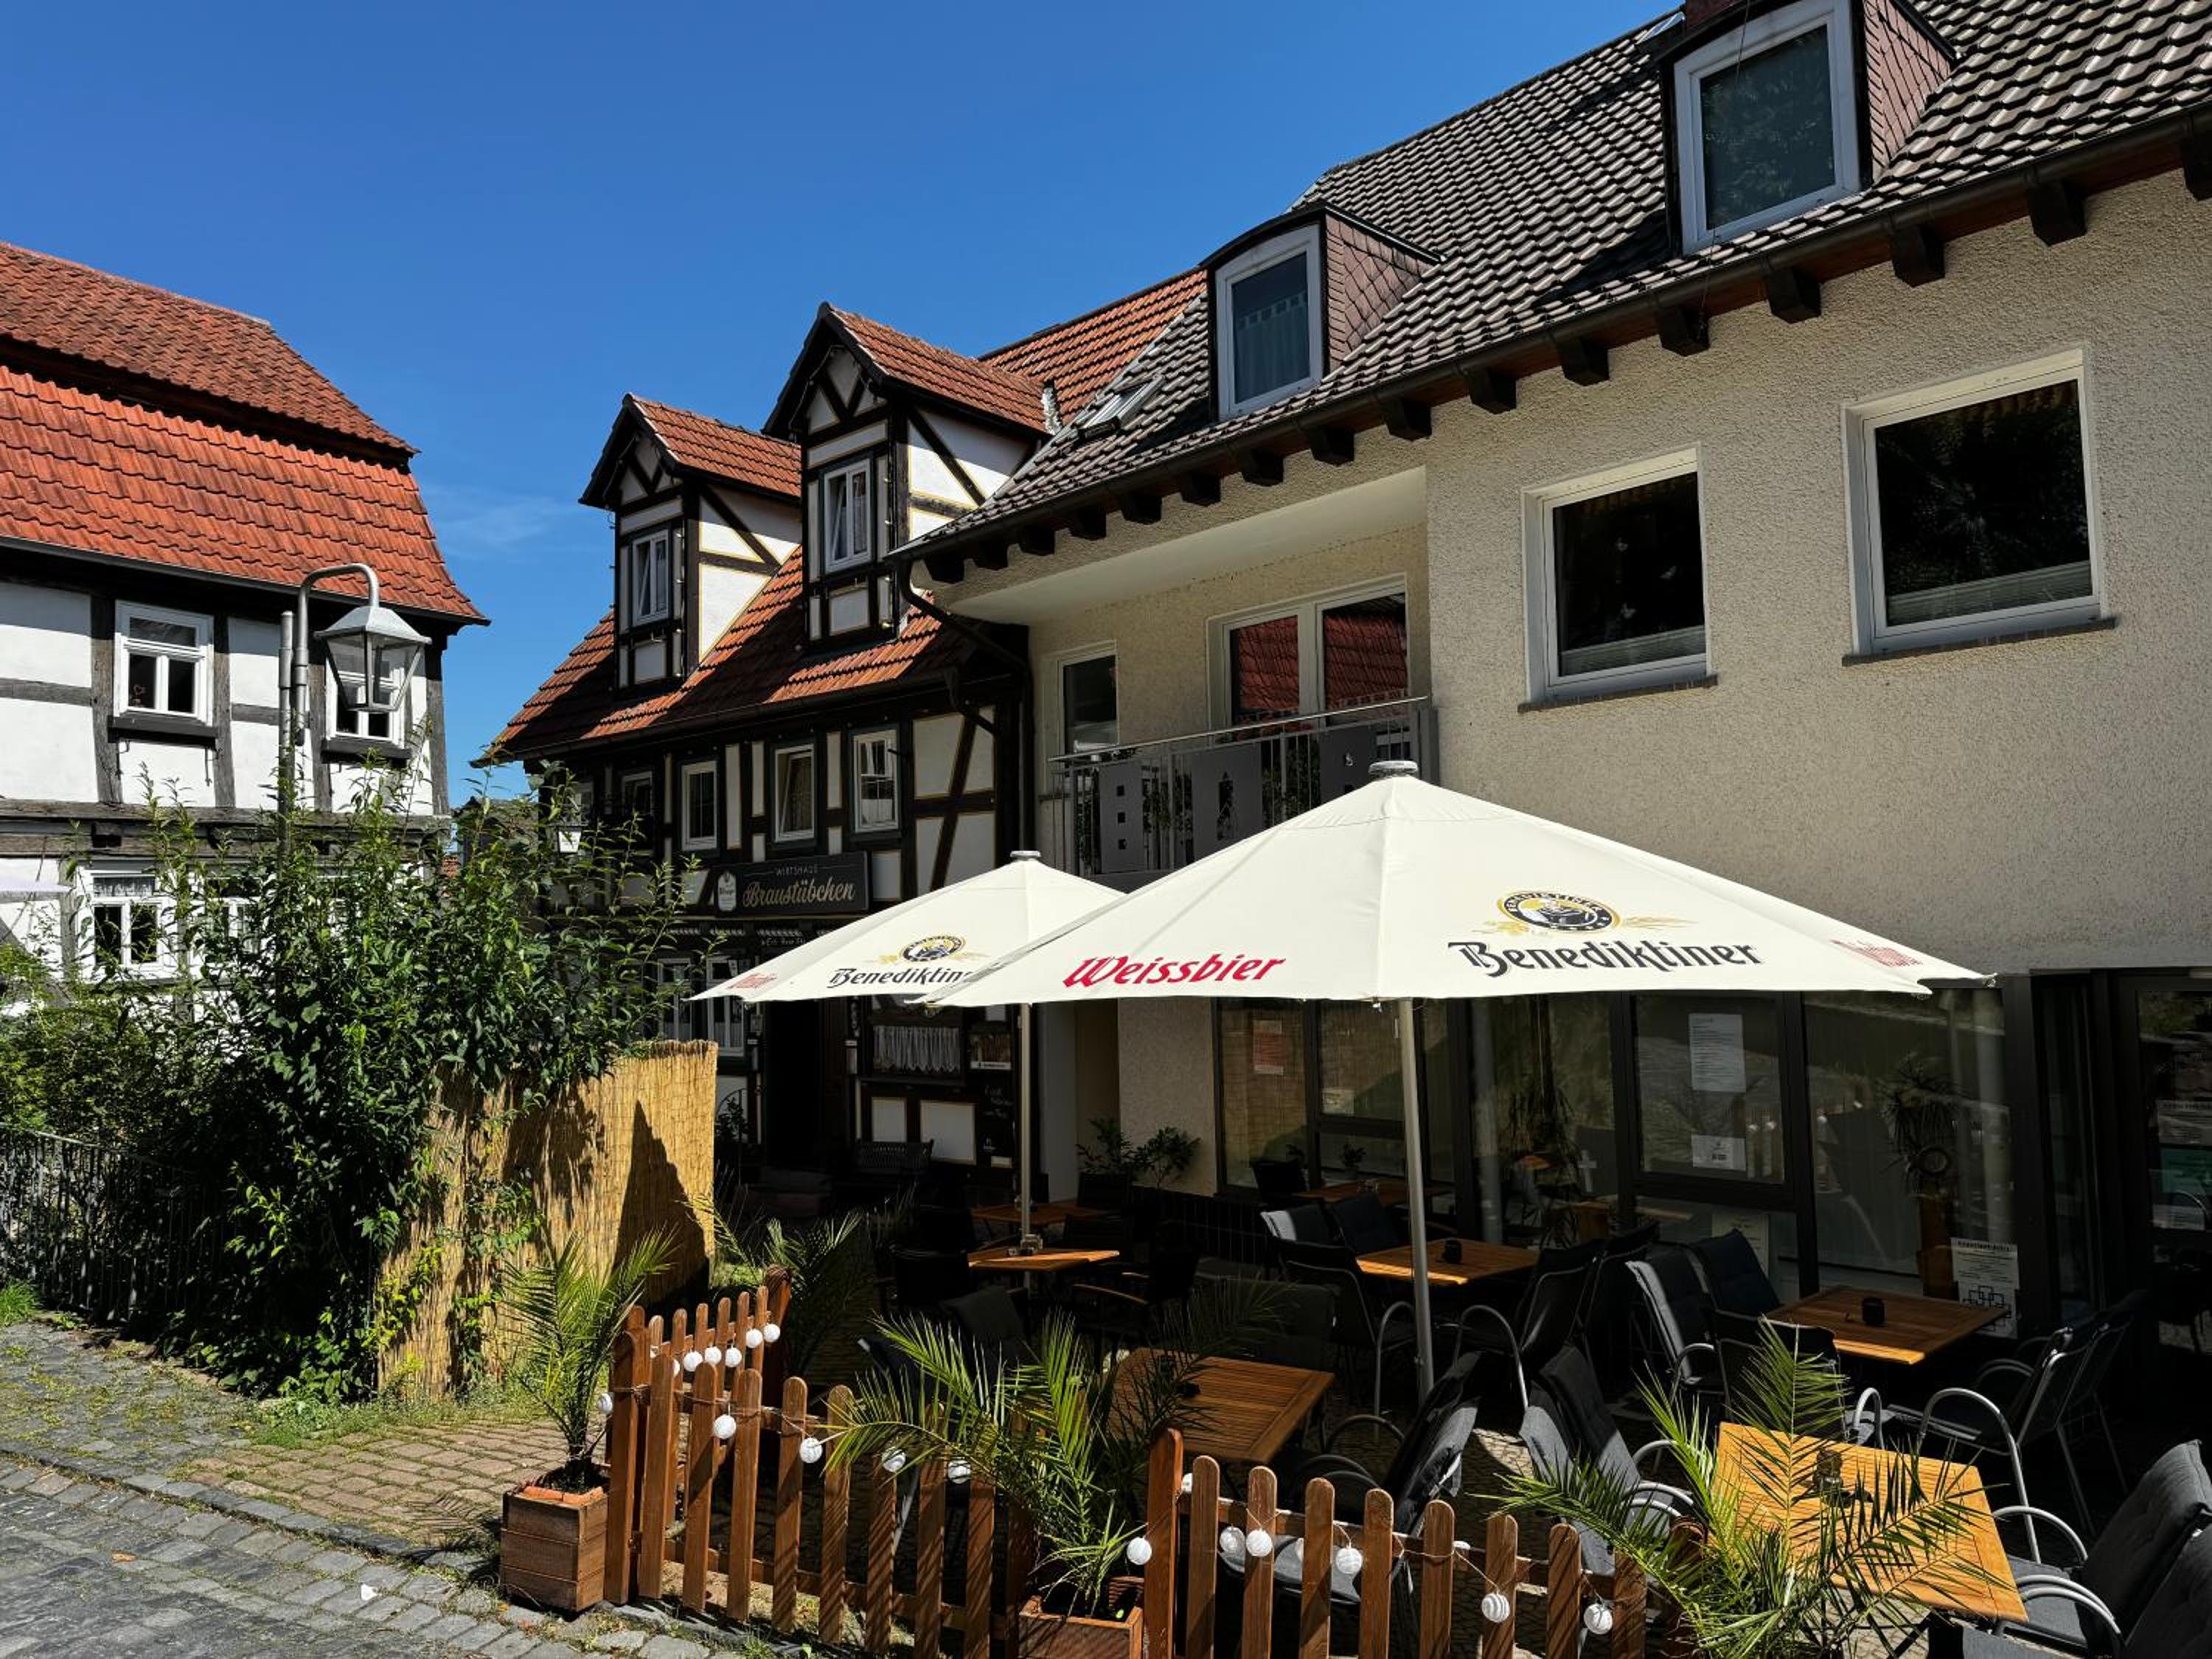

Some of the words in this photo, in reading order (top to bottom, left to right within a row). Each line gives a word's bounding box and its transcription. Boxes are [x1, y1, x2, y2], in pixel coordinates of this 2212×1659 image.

[743, 876, 855, 908] Braustübchen
[1062, 953, 1286, 988] Weissbier
[1448, 939, 1761, 978] Benediktiner
[827, 967, 972, 989] Benediktin
